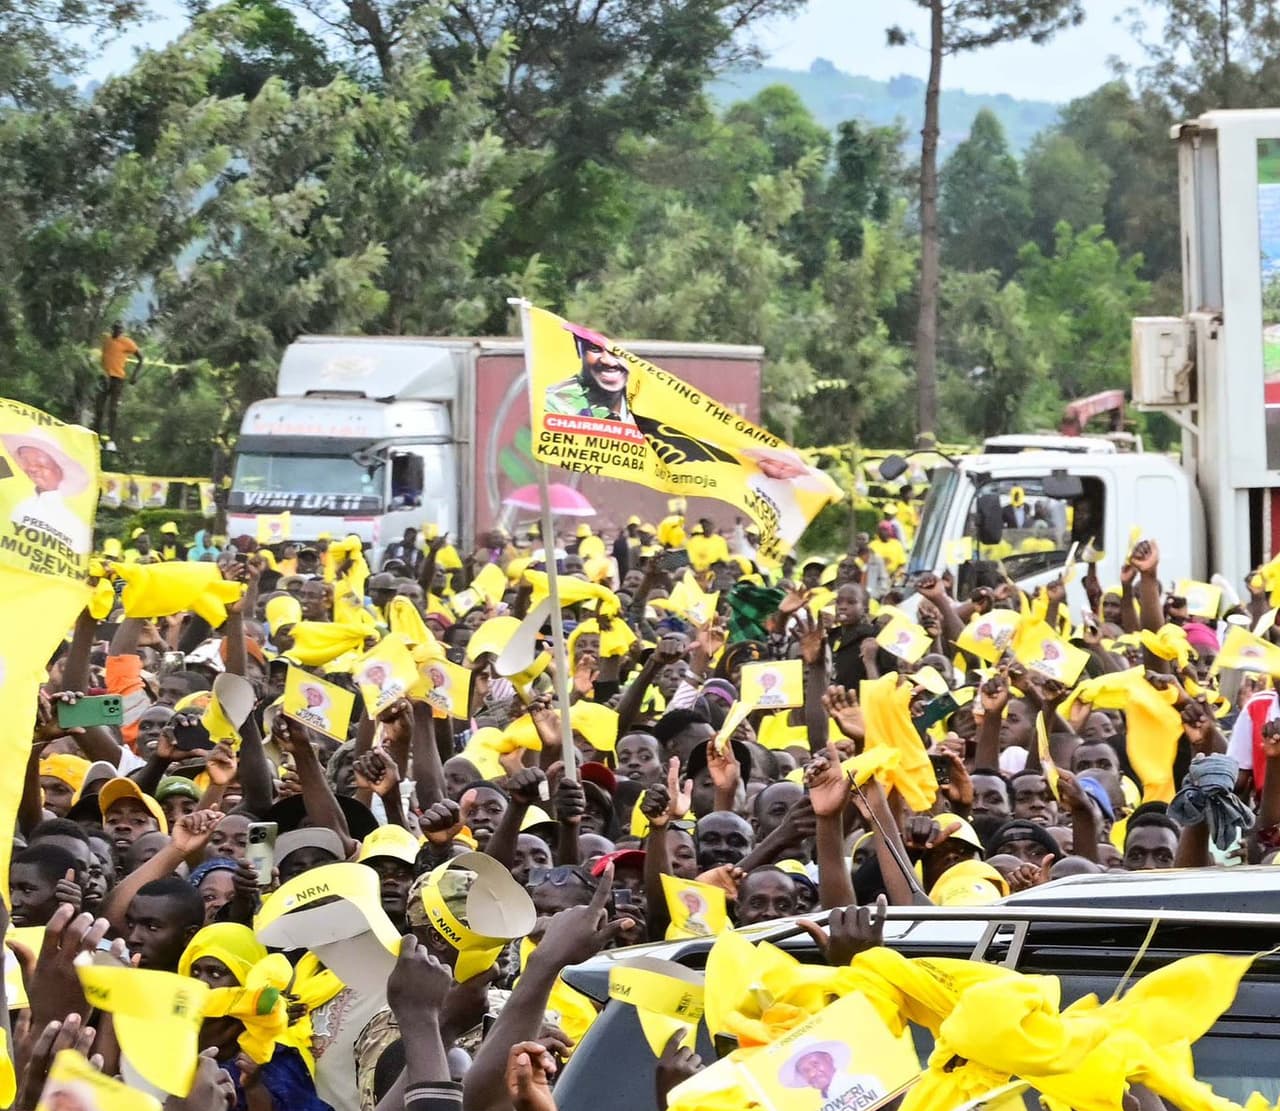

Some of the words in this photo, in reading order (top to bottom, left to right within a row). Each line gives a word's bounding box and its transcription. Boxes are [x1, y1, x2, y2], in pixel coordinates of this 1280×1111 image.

[547, 417, 619, 436] CHAIRMAN
[706, 401, 732, 429] THE
[540, 431, 578, 449] GEN.
[560, 462, 603, 480] NEXT
[12, 521, 81, 565] YOWERI
[0, 536, 90, 582] MUSEVEN
[296, 883, 331, 902] NRM
[436, 917, 462, 944] NRM
